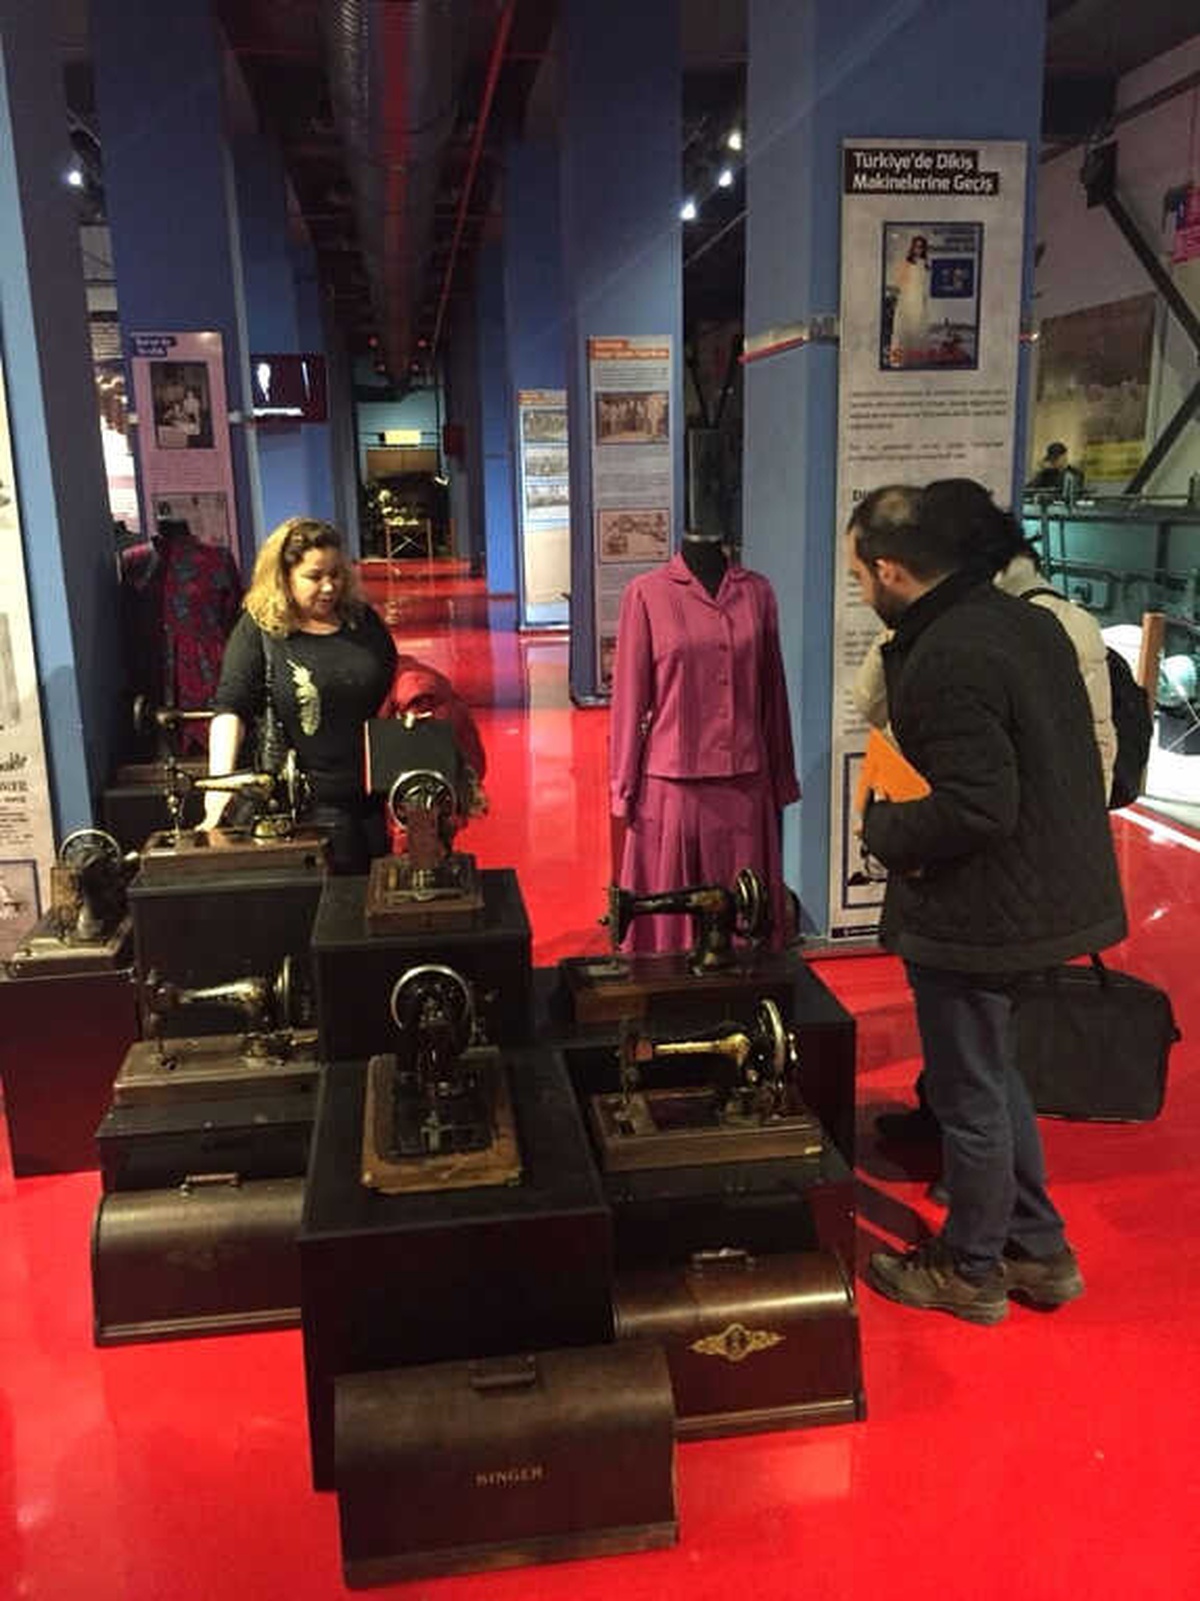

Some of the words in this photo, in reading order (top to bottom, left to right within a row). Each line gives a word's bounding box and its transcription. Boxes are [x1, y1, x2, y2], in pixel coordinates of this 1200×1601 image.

[853, 152, 934, 173] Türkiye'de
[936, 152, 974, 171] Dikiş
[852, 172, 951, 191] Makinelerine
[953, 174, 994, 193] Geçiş
[475, 1466, 543, 1487] SINGER
